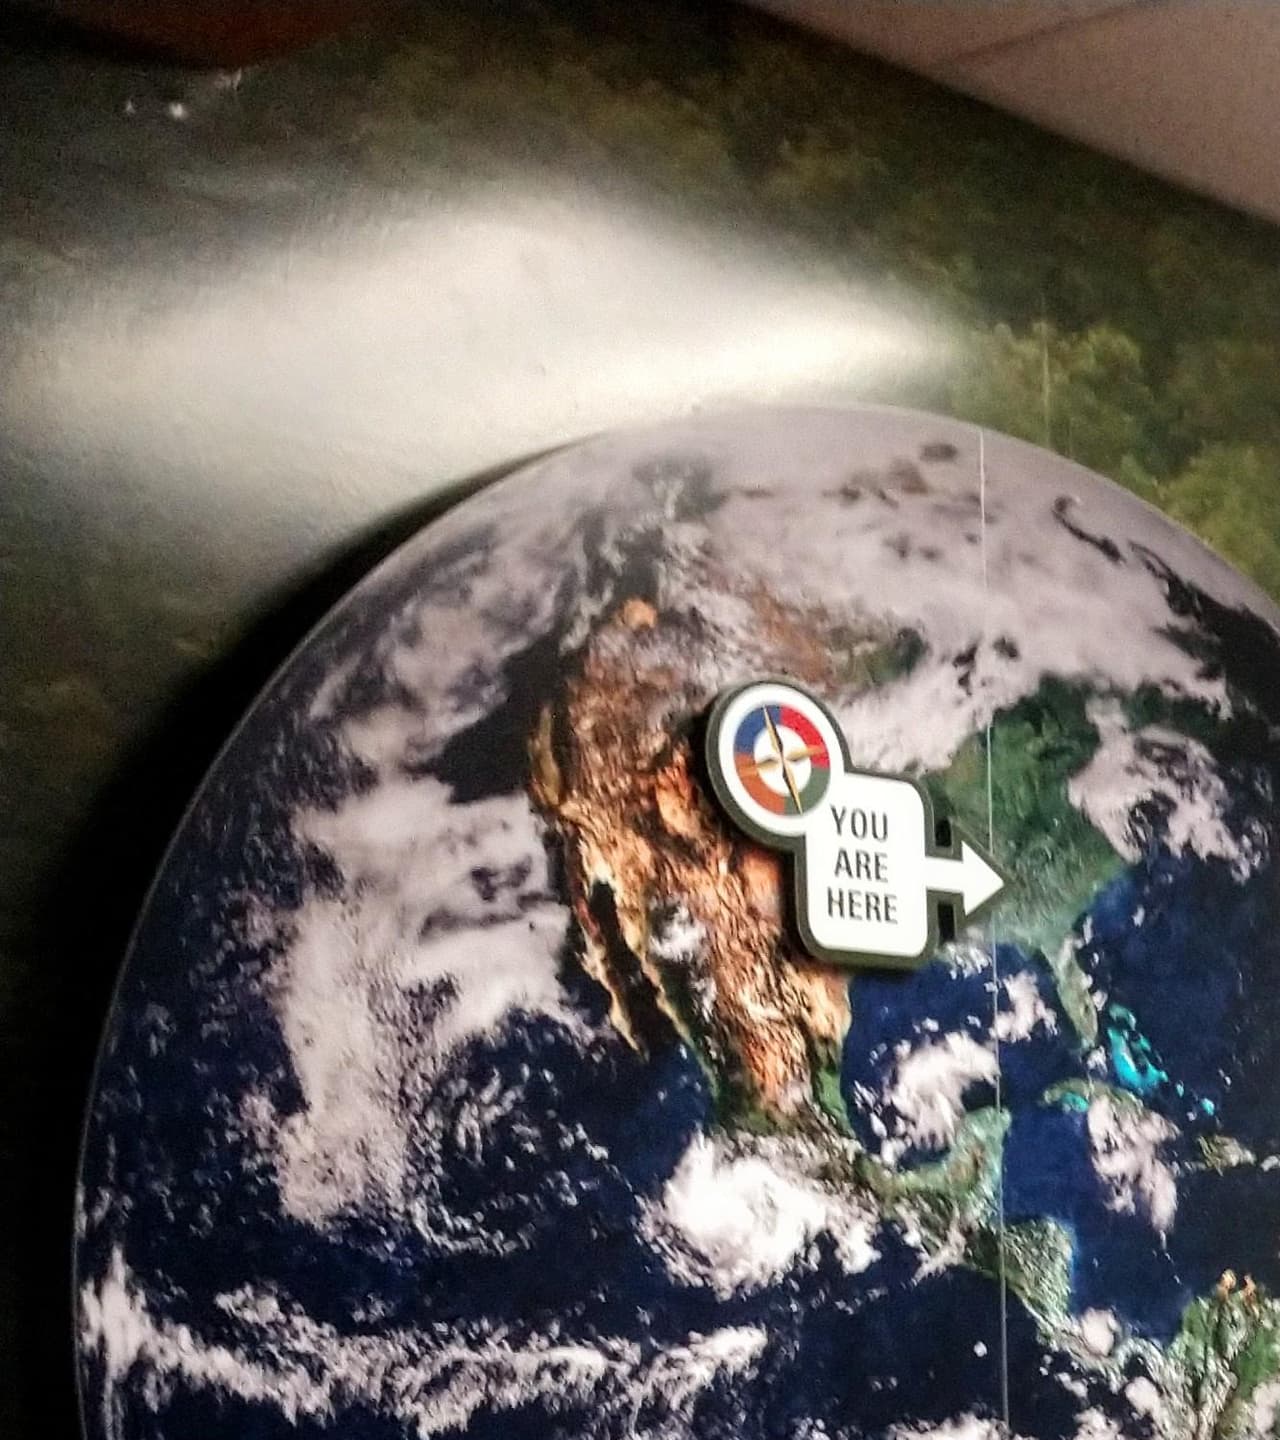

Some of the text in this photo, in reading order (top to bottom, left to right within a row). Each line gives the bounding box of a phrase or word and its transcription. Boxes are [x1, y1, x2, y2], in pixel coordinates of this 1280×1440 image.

[830, 804, 889, 842] YOU
[834, 848, 889, 884] ARE
[827, 886, 898, 925] HERE
